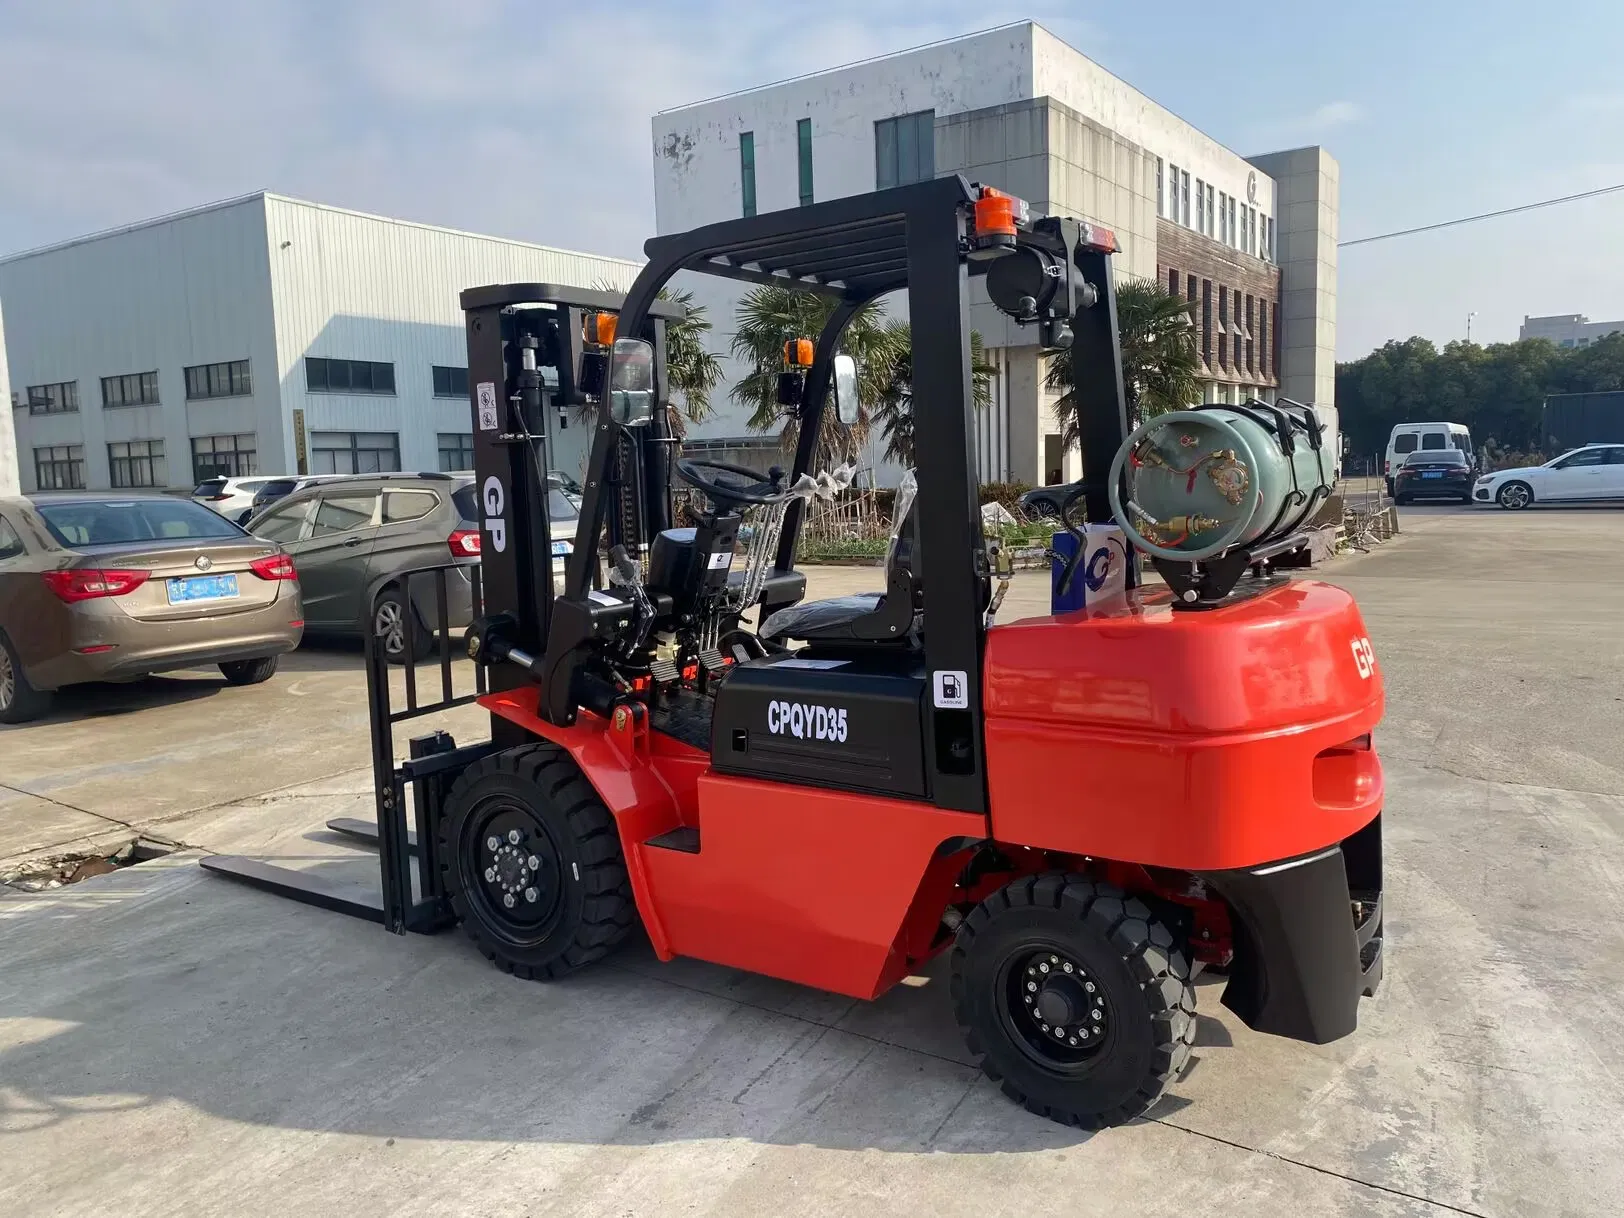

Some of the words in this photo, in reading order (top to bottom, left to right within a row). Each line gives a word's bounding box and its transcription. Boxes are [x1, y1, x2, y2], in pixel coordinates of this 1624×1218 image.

[483, 475, 506, 553] GP
[1351, 637, 1375, 680] GP
[767, 700, 848, 743] CPQYD35
